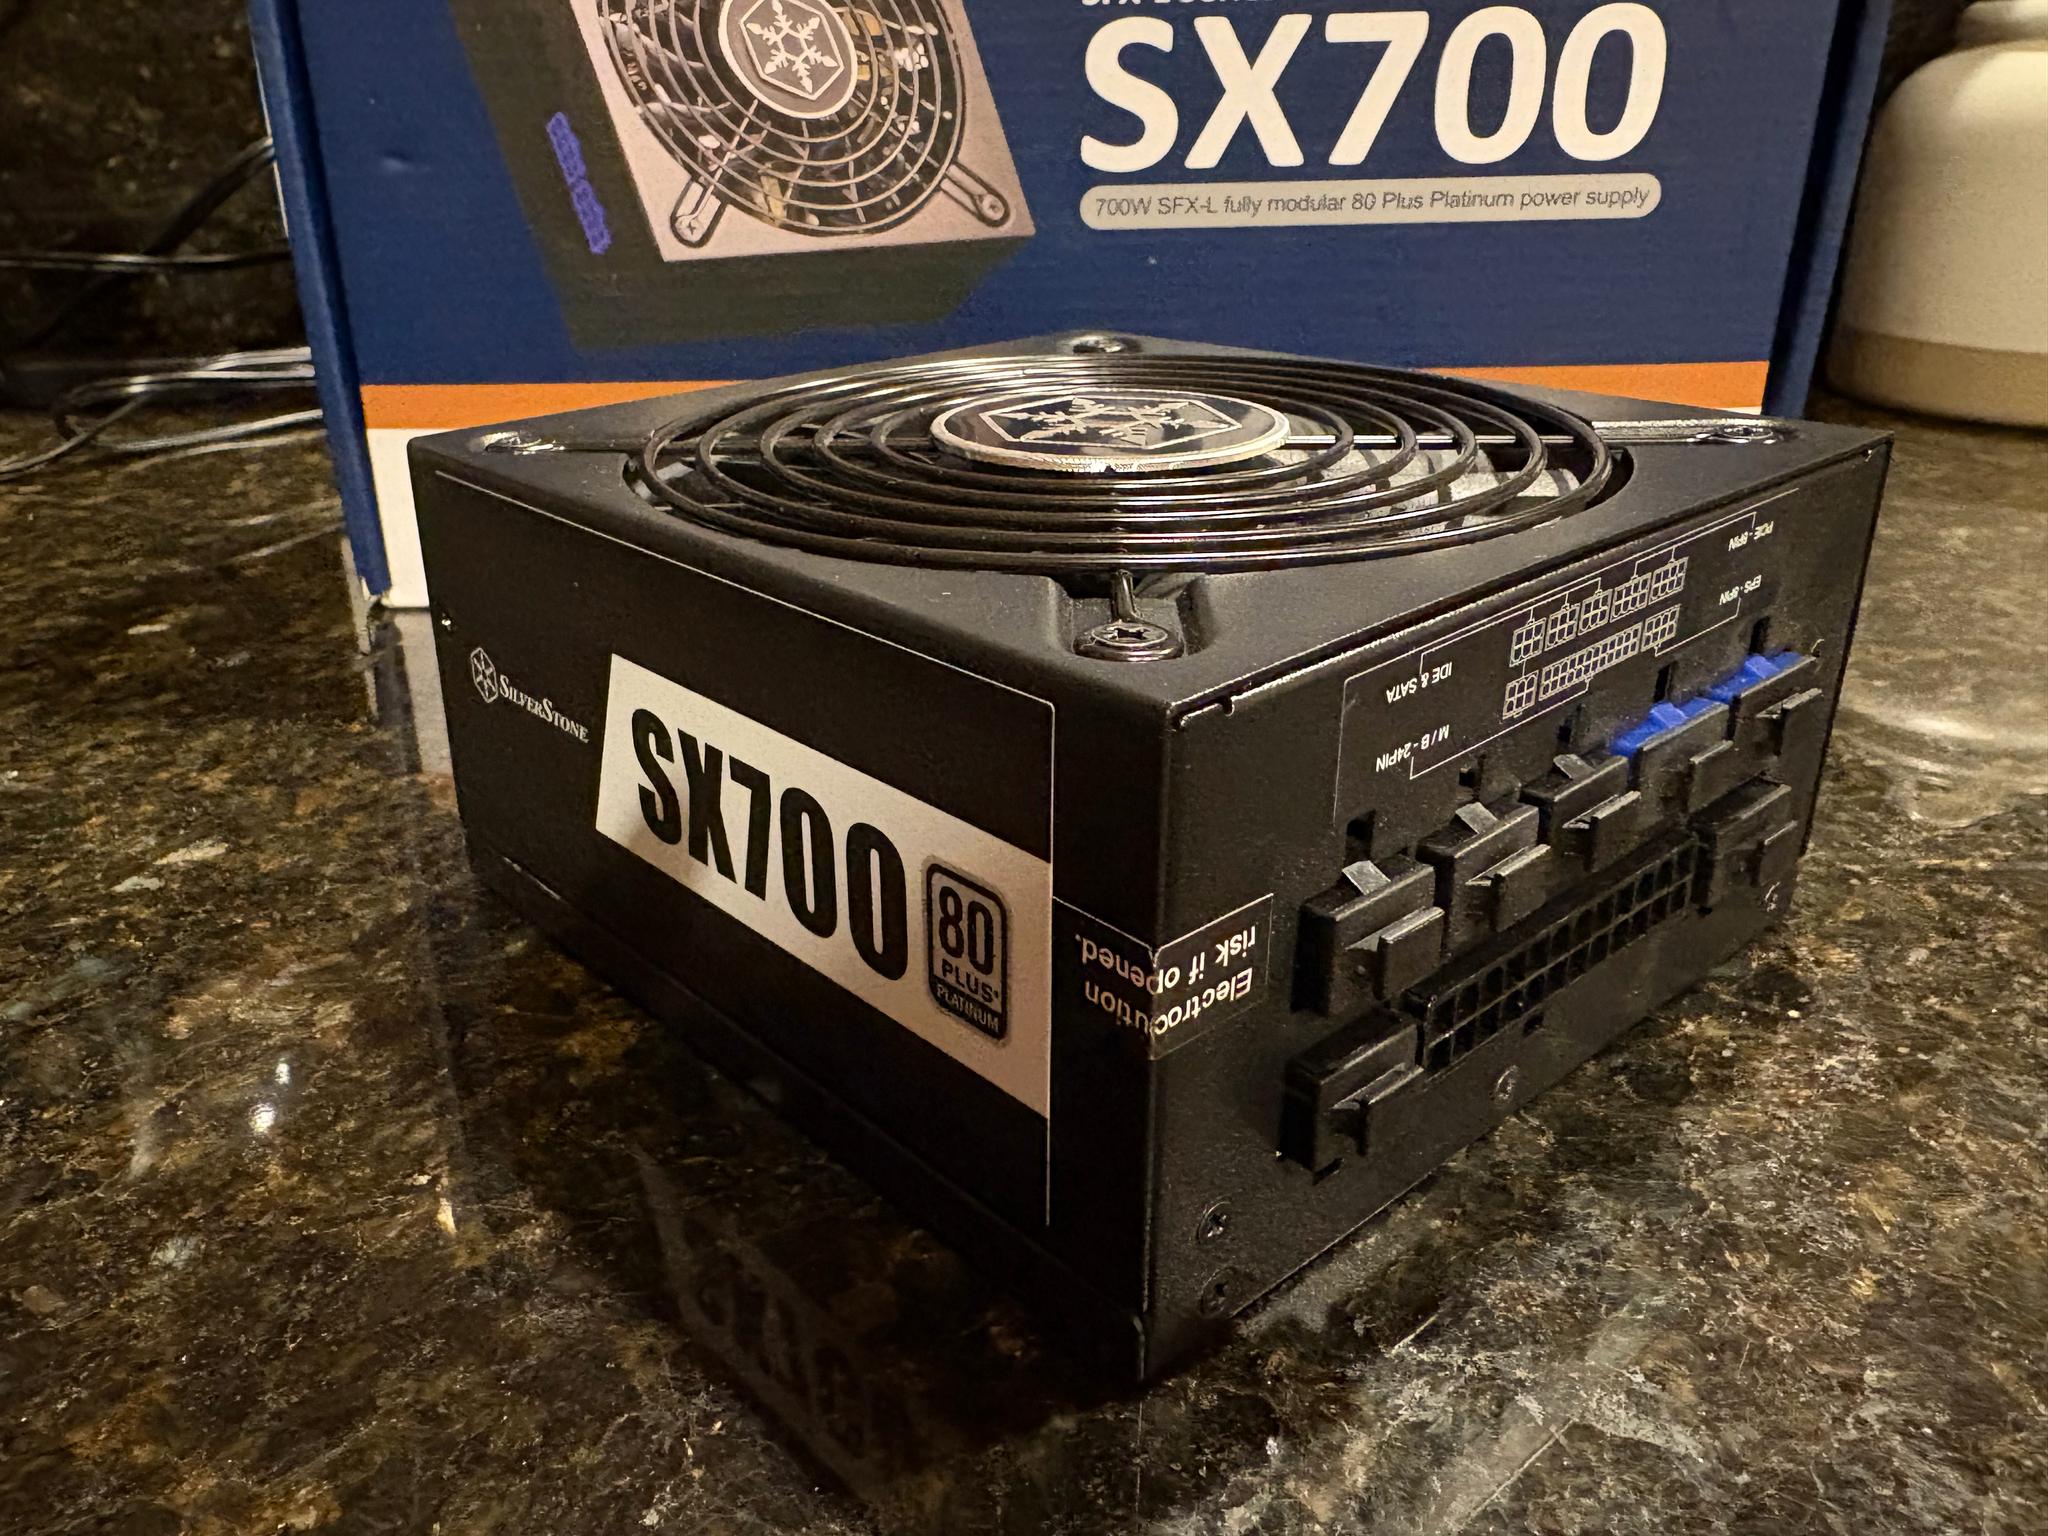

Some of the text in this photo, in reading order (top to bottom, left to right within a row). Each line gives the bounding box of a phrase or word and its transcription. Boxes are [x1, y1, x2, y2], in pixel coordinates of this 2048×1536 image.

[1081, 2, 1667, 172] SX700
[1096, 187, 1649, 218] 700W SFX-L fully modular 80 Plus Platinum power supply
[1385, 661, 1453, 704] IDE & SATA
[631, 708, 908, 981] SX700
[938, 885, 994, 976] 80
[1075, 926, 1256, 996] risk if opened.
[936, 984, 999, 1033] PLATINUM
[941, 958, 995, 1003] PLUS
[1084, 967, 1253, 1036] Electrocution
